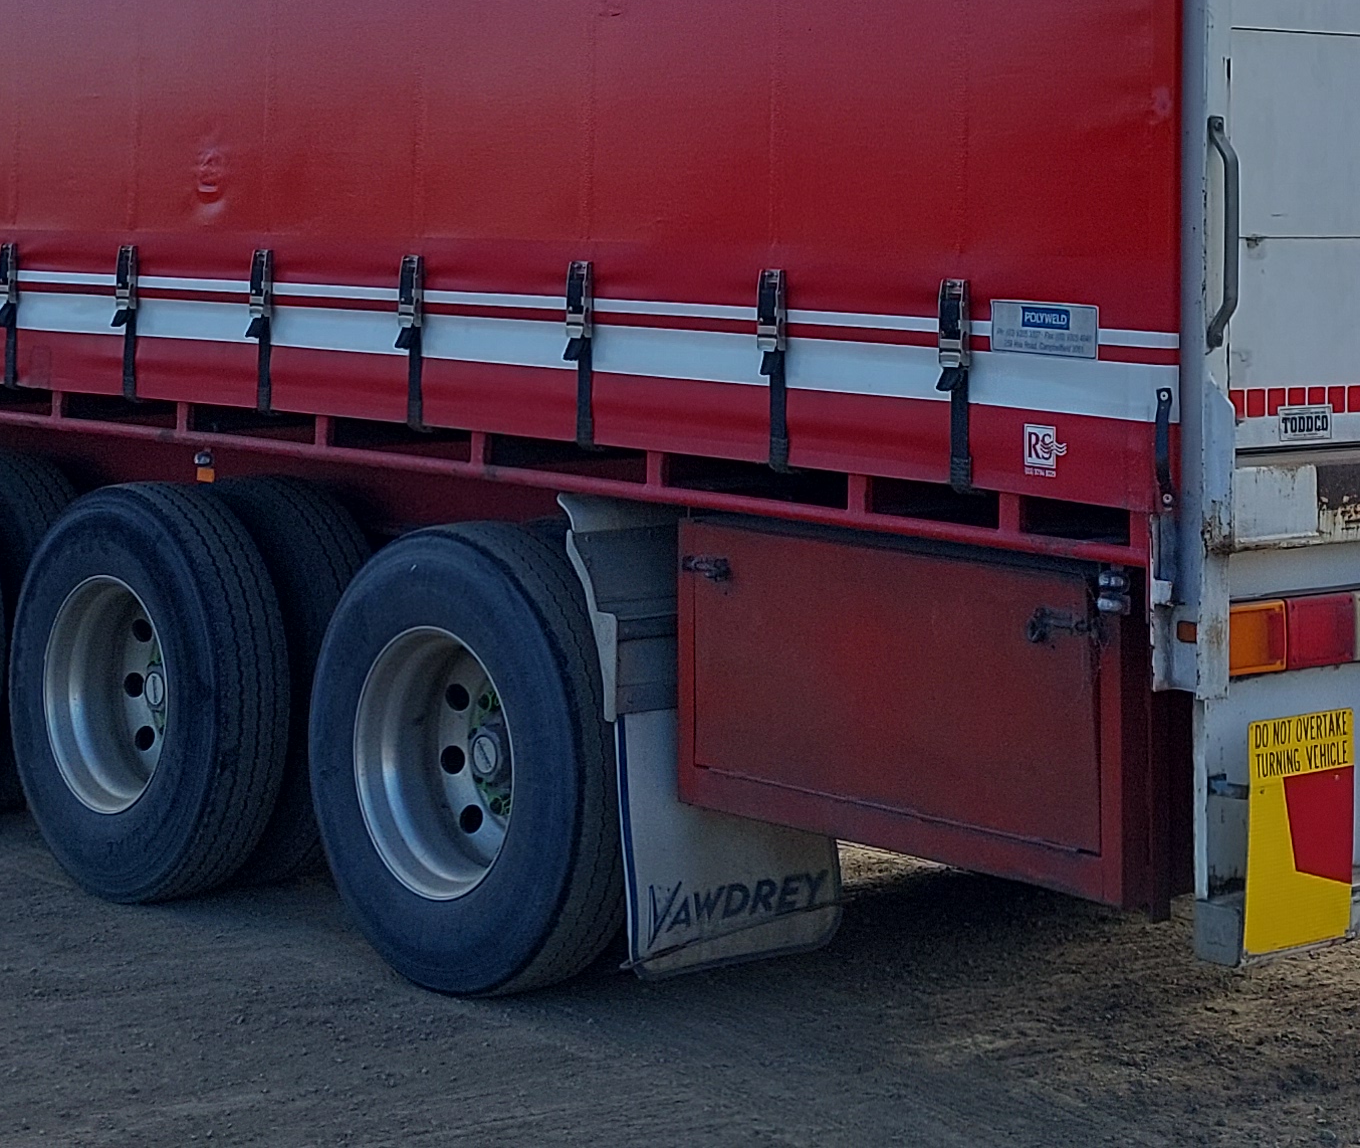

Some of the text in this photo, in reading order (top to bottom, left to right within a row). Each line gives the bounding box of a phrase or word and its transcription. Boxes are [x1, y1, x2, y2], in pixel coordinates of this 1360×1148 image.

[1023, 311, 1068, 325] POLYWELD
[1281, 414, 1329, 434] TODDCO
[1254, 711, 1348, 750] DO NOT OVERTAKE
[1254, 739, 1349, 779] TURNING VEHICLE
[646, 868, 830, 950] VAWDREY
